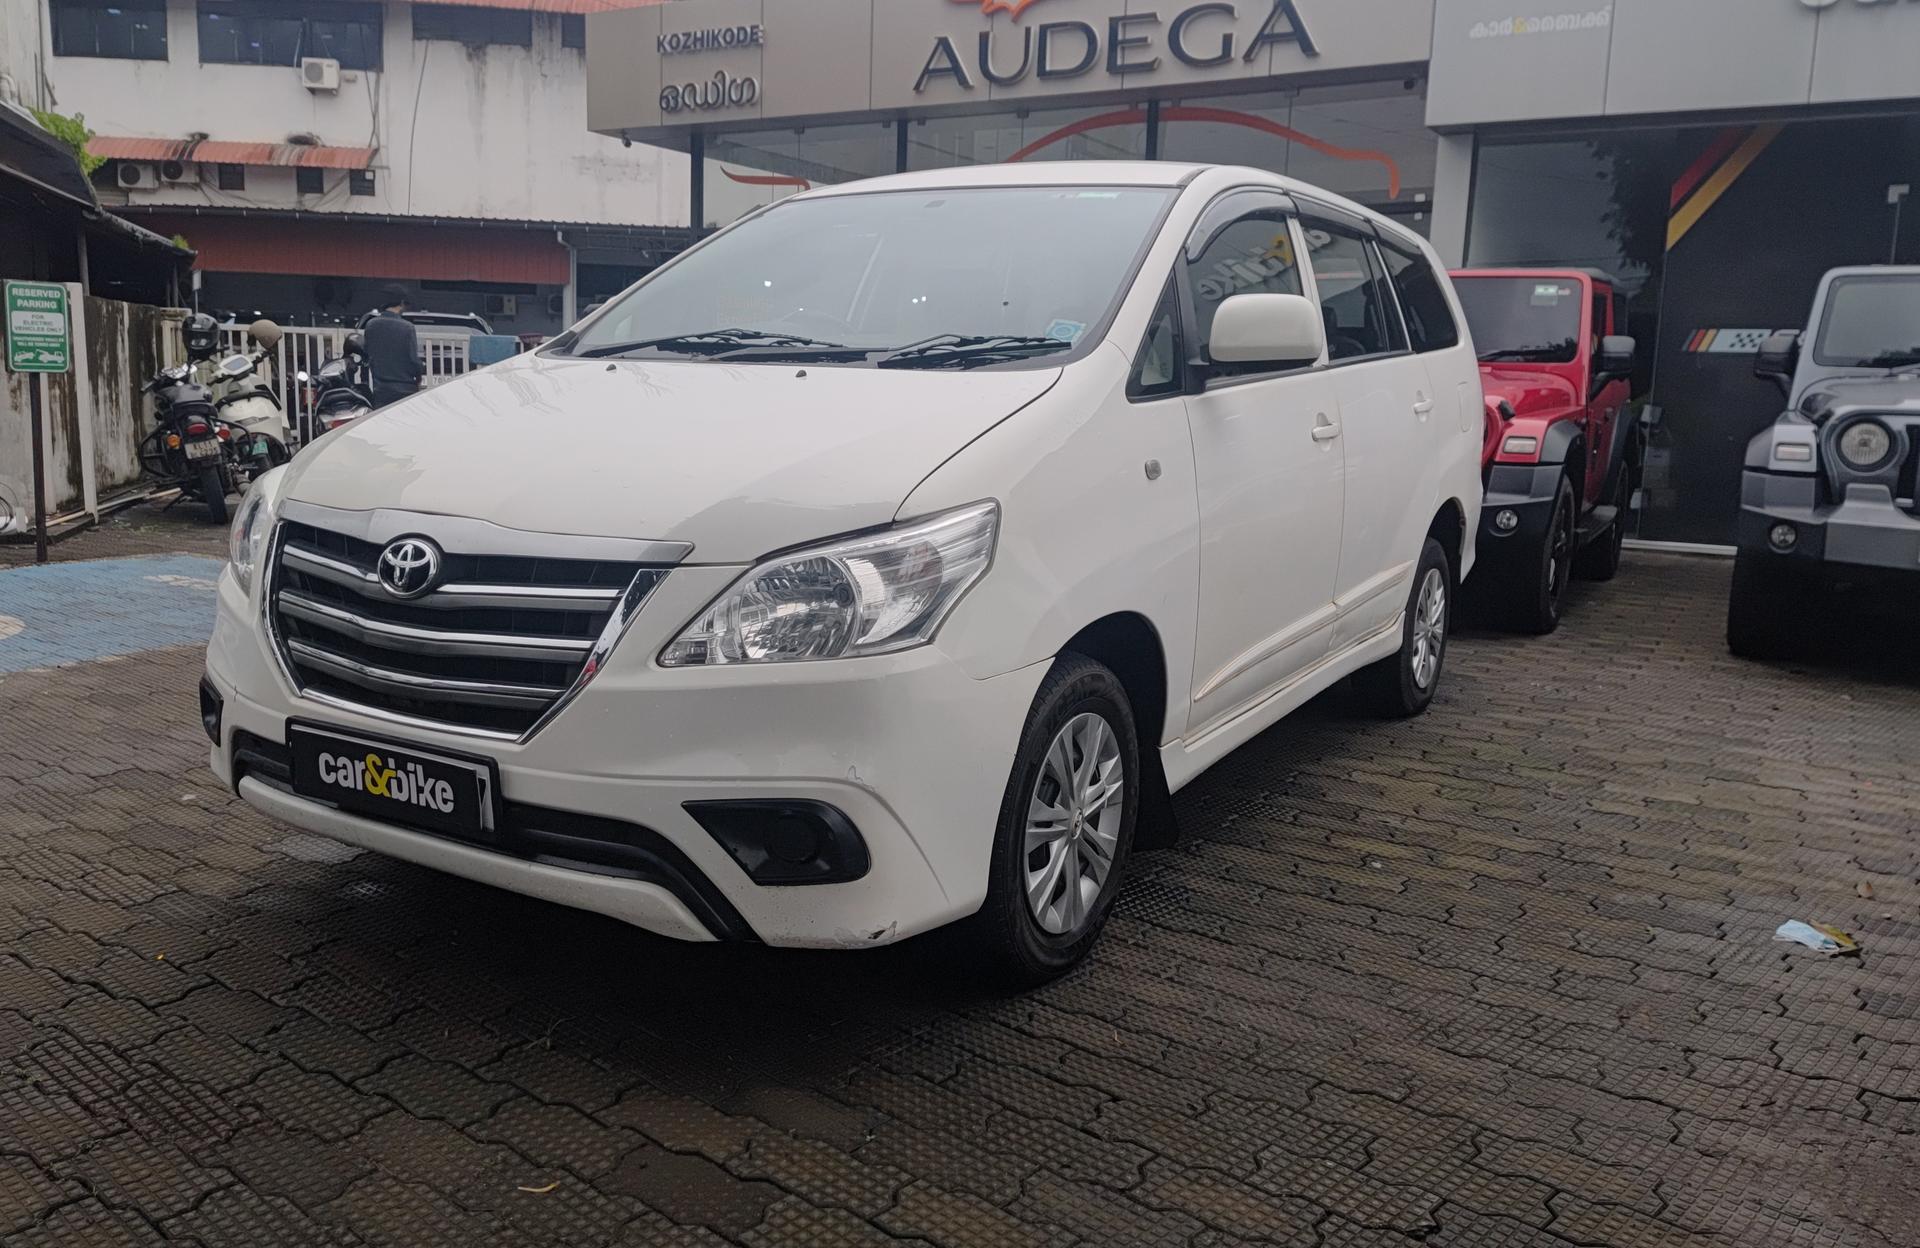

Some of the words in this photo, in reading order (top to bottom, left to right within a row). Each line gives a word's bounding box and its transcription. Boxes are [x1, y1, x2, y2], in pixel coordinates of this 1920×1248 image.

[657, 24, 763, 53] KOZHIKODE
[913, 0, 1320, 92] AUDEGA
[12, 288, 60, 298] RESERVED
[17, 298, 57, 309] PARKING
[318, 752, 455, 813] car&bike
